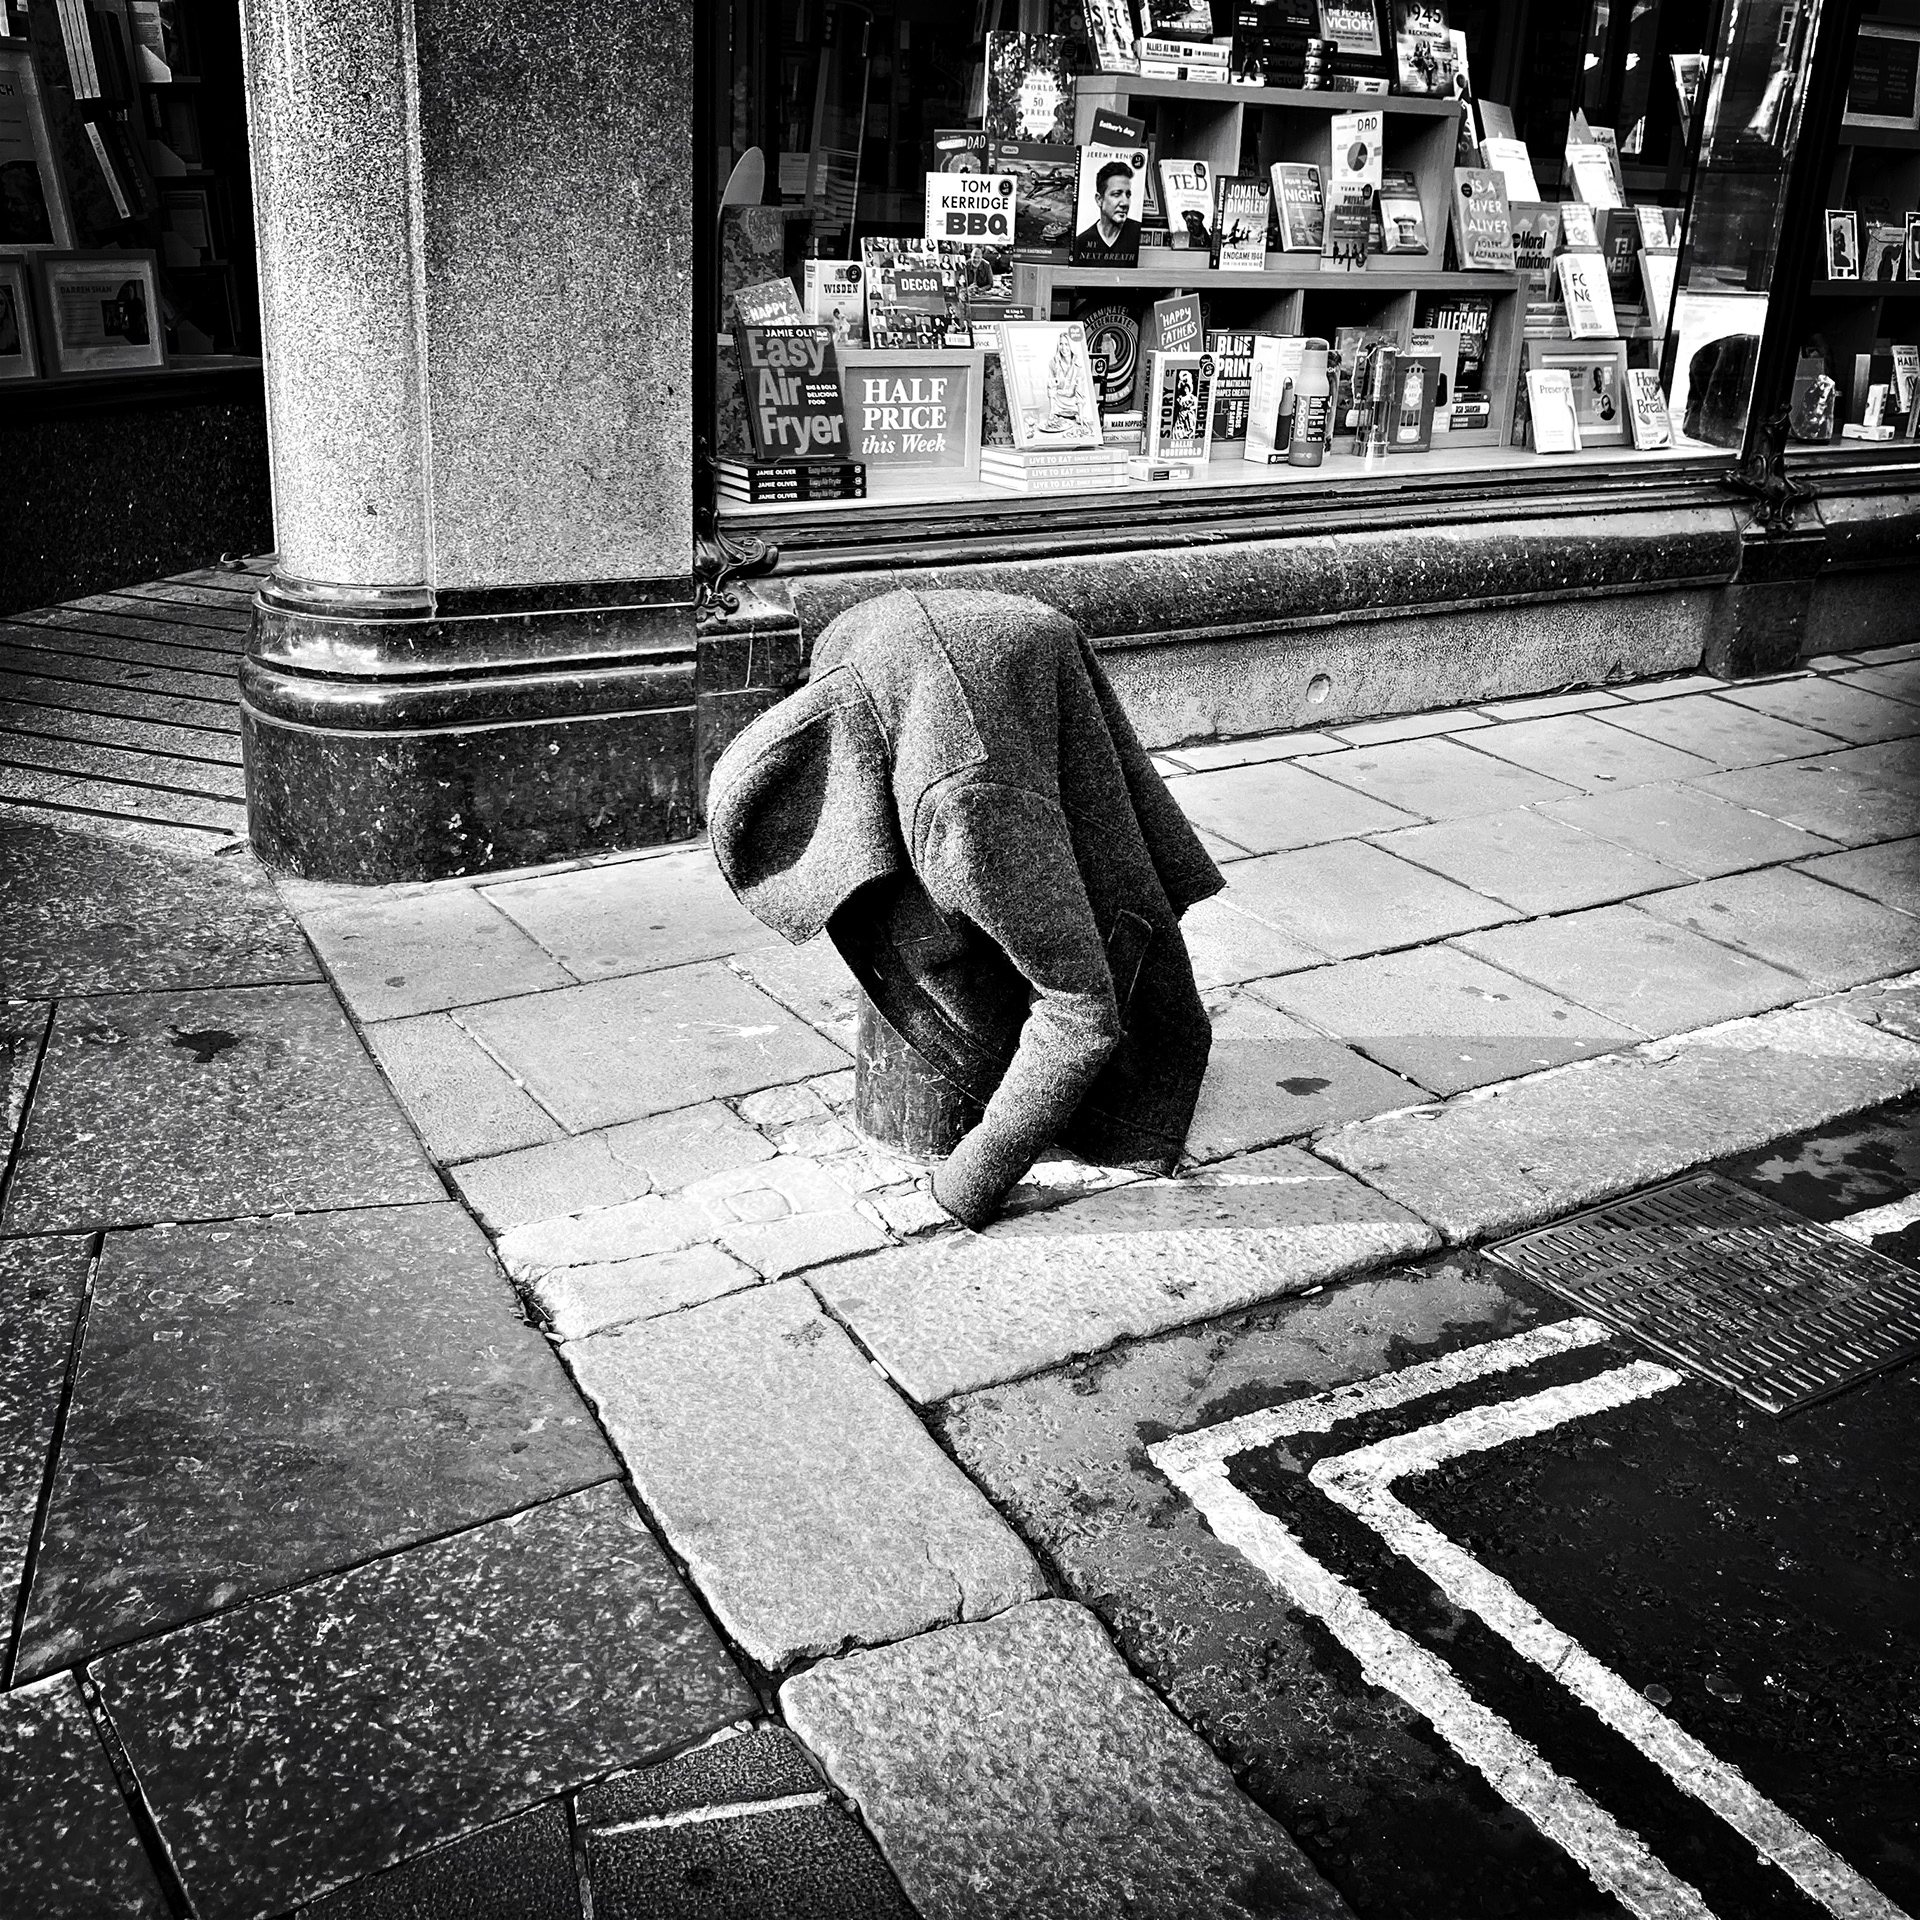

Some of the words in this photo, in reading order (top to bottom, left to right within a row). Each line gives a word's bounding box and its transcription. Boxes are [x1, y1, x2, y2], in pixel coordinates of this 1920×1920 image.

[1328, 8, 1340, 18] THE
[1341, 10, 1372, 20] PEOPLE'S
[1406, 4, 1442, 24] 1945
[1326, 17, 1374, 31] VICTORY
[1408, 30, 1442, 38] RECKONING
[1146, 43, 1162, 51] ALLIES
[1170, 45, 1180, 53] WAR
[1272, 38, 1306, 49] VICTORY
[1270, 57, 1304, 67] VICTORY
[1268, 74, 1303, 84] VICTORY
[1033, 98, 1044, 106] 50
[1025, 108, 1050, 116] TREES
[1358, 117, 1378, 131] DAD
[967, 135, 986, 149] DAD
[961, 180, 990, 193] TOM
[1169, 174, 1208, 191] TED
[1471, 179, 1482, 192] IS
[1487, 181, 1496, 193] A
[1228, 184, 1270, 199] JONAT
[1285, 189, 1320, 202] NIGHT
[942, 196, 1009, 210] KERRIDGE
[1226, 199, 1269, 214] DIMBLEBY
[1469, 199, 1502, 213] RIVER
[946, 212, 1008, 236] BBQ
[1468, 219, 1507, 233] ALIVE?
[1521, 231, 1547, 249] Moral
[1104, 252, 1135, 260] BREATH
[1223, 252, 1250, 260] ENDGAME
[1469, 251, 1513, 260] MACFARLANE
[824, 283, 858, 294] WISDEN
[901, 277, 938, 292] DECCA
[750, 301, 788, 321] HAPPY
[1460, 303, 1470, 311] THE
[1162, 306, 1191, 326] HAPPY
[765, 329, 794, 337] JAMIE
[796, 329, 815, 337] OLI
[1161, 321, 1198, 346] FATHER'S
[746, 330, 825, 376] Easy
[1171, 341, 1190, 352] DAY
[1217, 336, 1253, 356] BLUE
[1217, 358, 1253, 377] PRIN
[1897, 356, 1918, 366] HABIT
[1226, 380, 1250, 388] MATHEMAT
[1636, 372, 1659, 386] How
[759, 368, 801, 406] Air
[862, 378, 948, 404] HALF
[1540, 385, 1569, 394] Presence
[1642, 387, 1659, 401] We
[1160, 387, 1174, 438] STORY
[1195, 381, 1210, 438] MURDER
[1637, 399, 1666, 414] Break
[862, 406, 947, 430] PRICE
[759, 407, 843, 455] Fryer
[862, 434, 896, 454] this
[902, 433, 946, 453] Week
